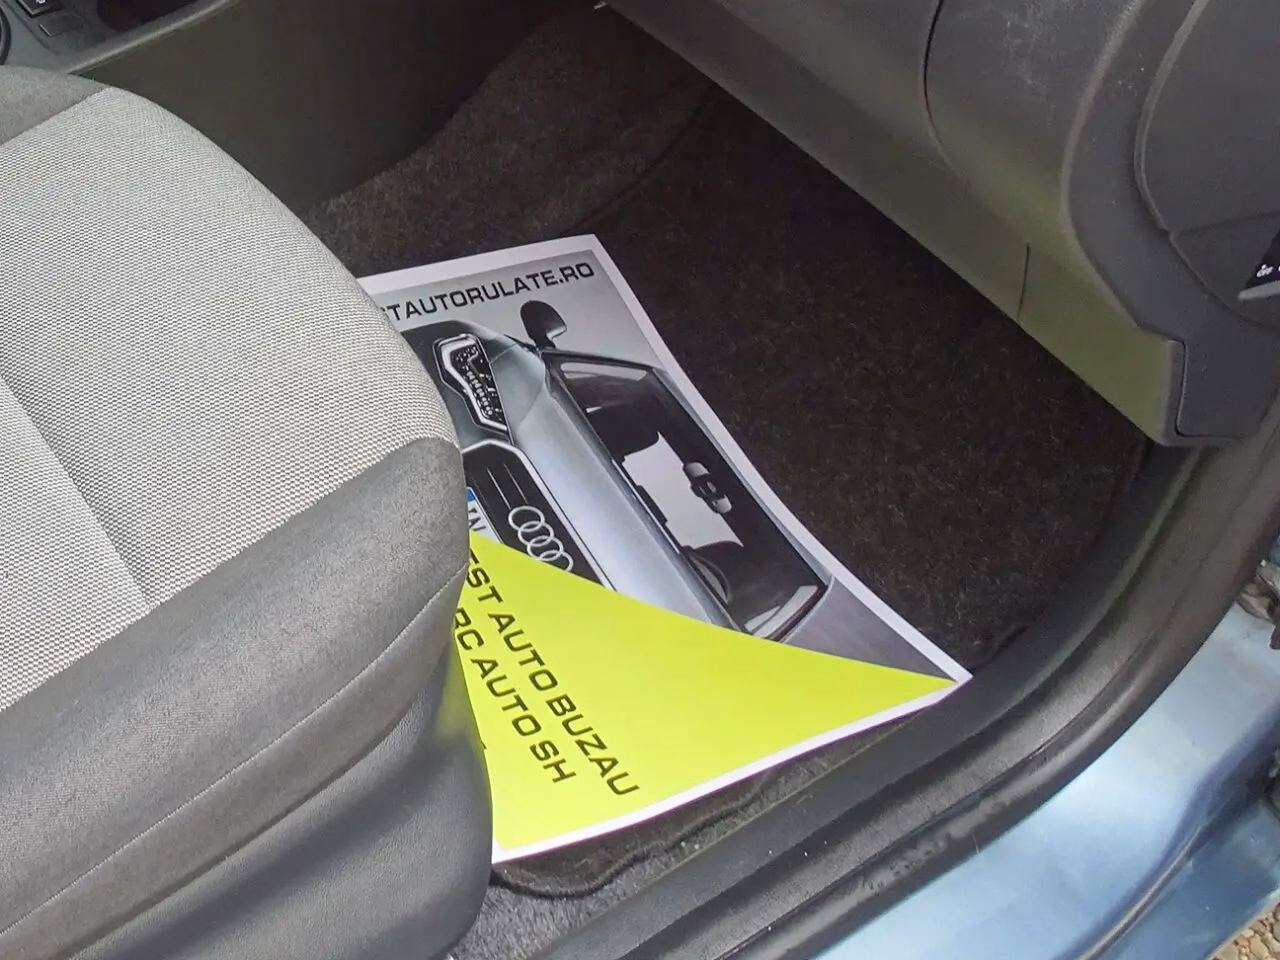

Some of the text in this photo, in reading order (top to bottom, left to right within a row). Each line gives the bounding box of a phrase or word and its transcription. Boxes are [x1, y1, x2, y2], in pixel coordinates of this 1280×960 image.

[380, 262, 595, 321] TAUTORULATE.RO
[470, 657, 542, 737] AUTO
[529, 740, 577, 783] SH
[487, 612, 559, 691] AUTO
[545, 693, 640, 796] BUZAU
